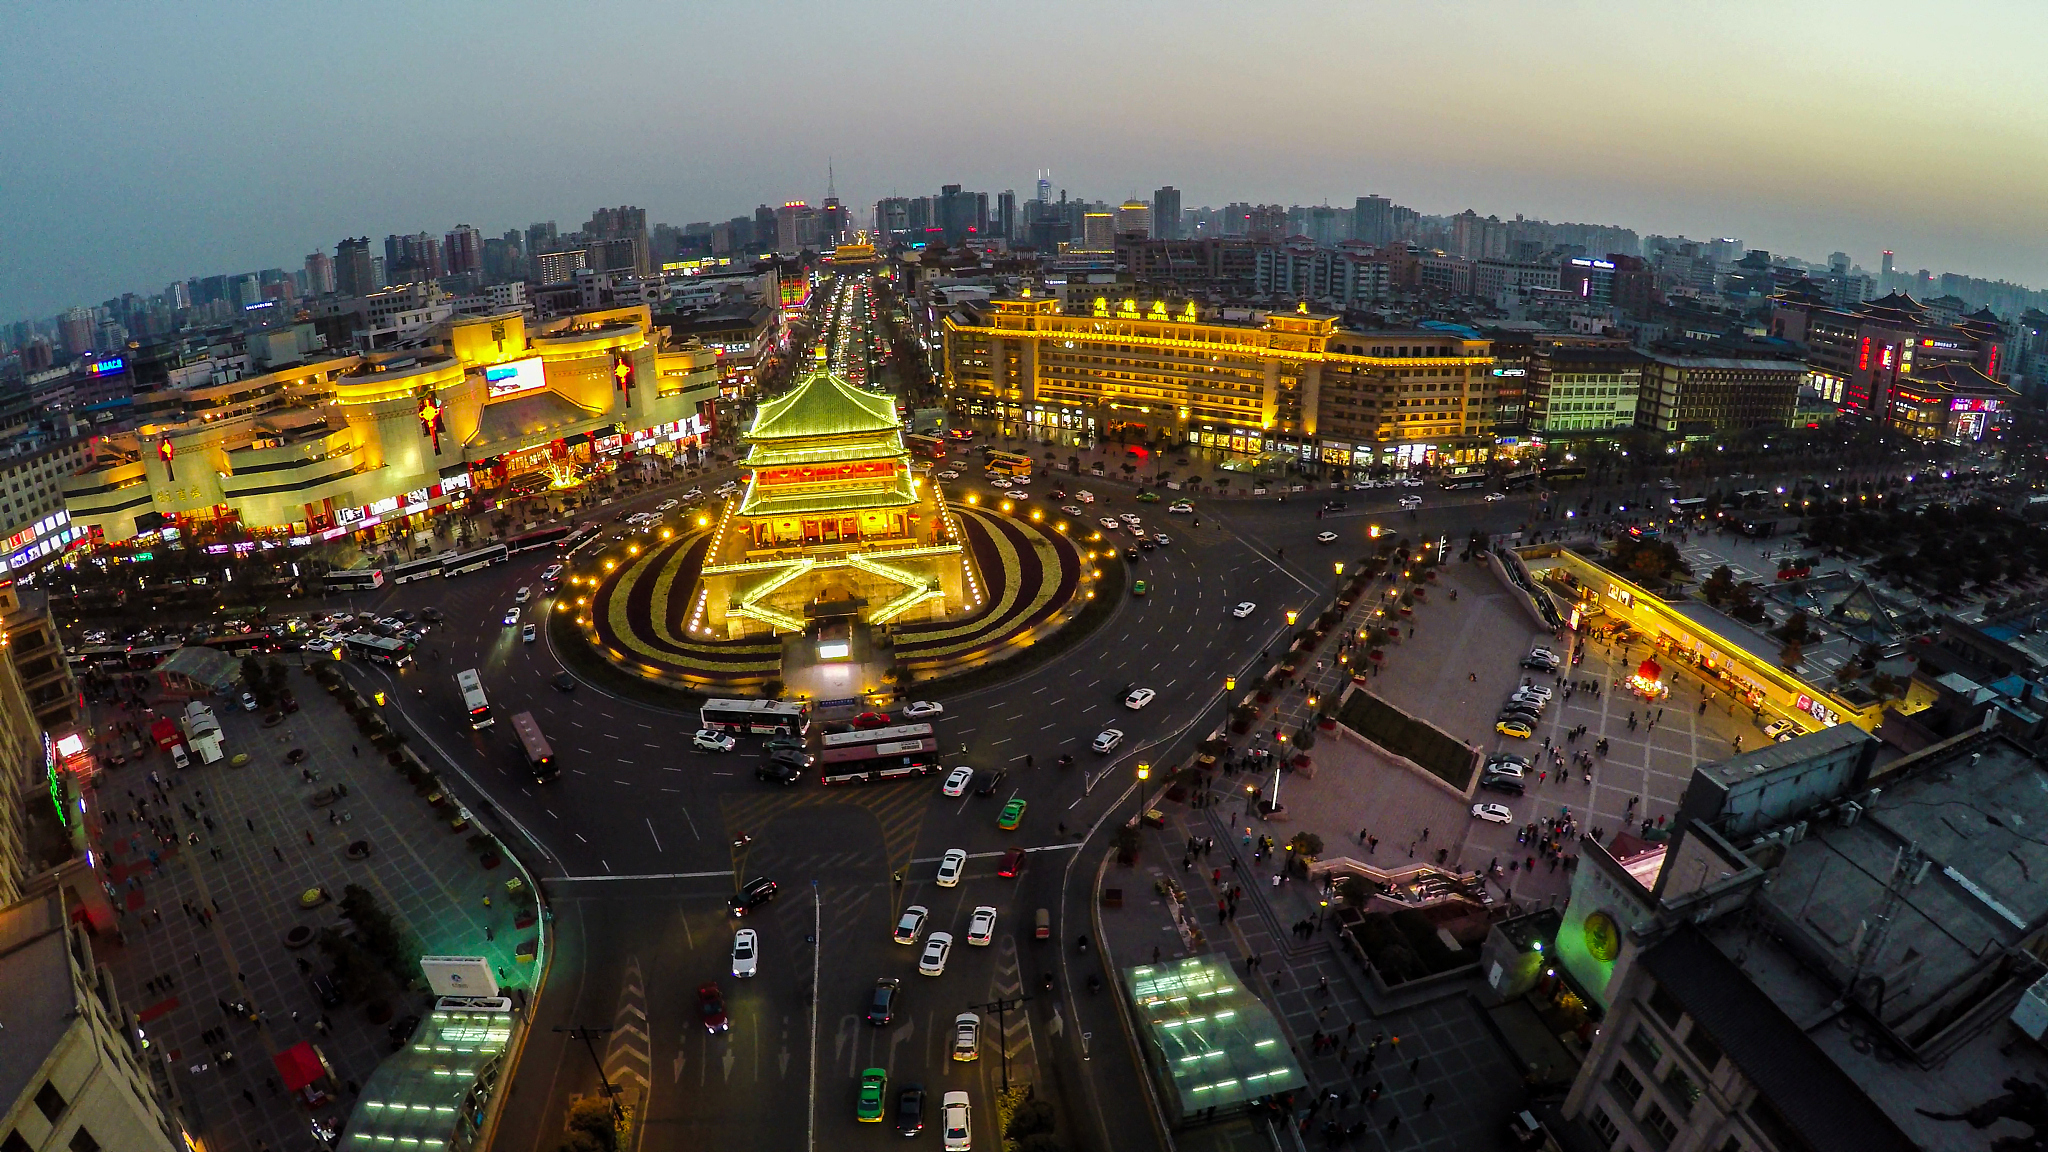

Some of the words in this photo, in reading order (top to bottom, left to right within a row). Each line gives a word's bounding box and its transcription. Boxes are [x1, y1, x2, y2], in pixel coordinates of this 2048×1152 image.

[1093, 309, 1110, 318] BELL
[1116, 311, 1141, 320] TOWER
[1147, 312, 1170, 321] HOTEL
